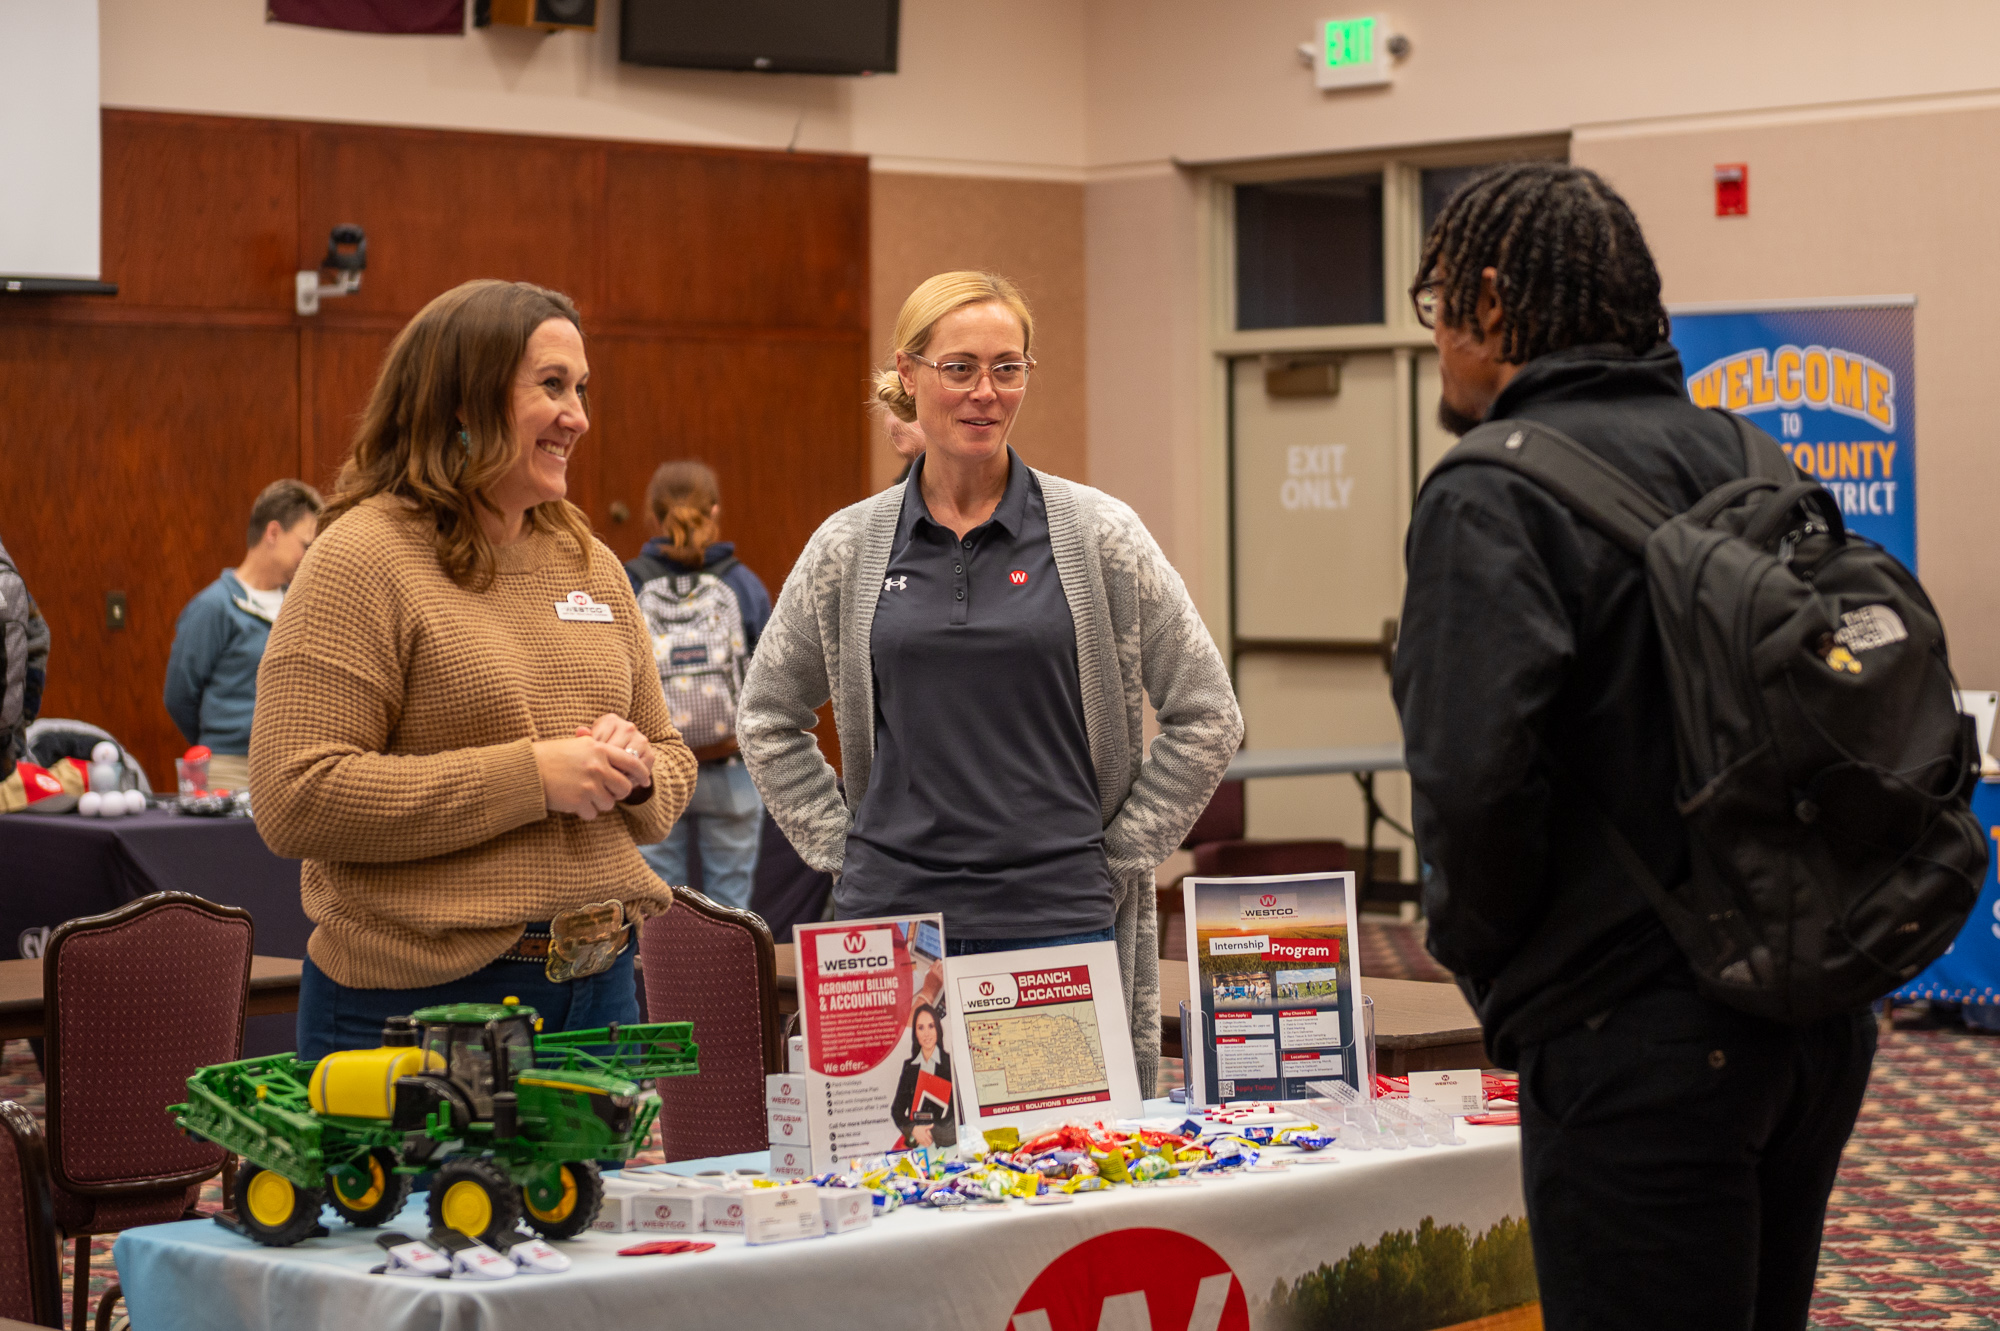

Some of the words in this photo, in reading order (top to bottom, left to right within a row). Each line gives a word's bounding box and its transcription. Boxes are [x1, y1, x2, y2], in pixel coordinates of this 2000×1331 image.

[1325, 17, 1375, 69] EXIT
[1688, 346, 1895, 432] WELCOME
[1781, 412, 1802, 437] TO
[1287, 445, 1347, 475] EXIT
[1280, 477, 1354, 510] ONLY
[1011, 572, 1027, 584] W
[1245, 908, 1293, 917] WESTCO
[1215, 939, 1264, 950] Internship
[1271, 943, 1330, 959] Program
[824, 955, 888, 971] WESTCO
[818, 980, 865, 996] AGRONOMY
[866, 976, 899, 991] BILLING
[1018, 971, 1071, 987] BRANCH
[830, 990, 896, 1011] ACCOUNTING
[1020, 984, 1091, 1002] LOCATIONS
[967, 997, 1011, 1008] WESTCO
[823, 1062, 838, 1073] We
[992, 1105, 1020, 1114] SERVICE
[1025, 1100, 1061, 1110] SOLUTIONS
[1066, 1095, 1096, 1105] SUCCESS
